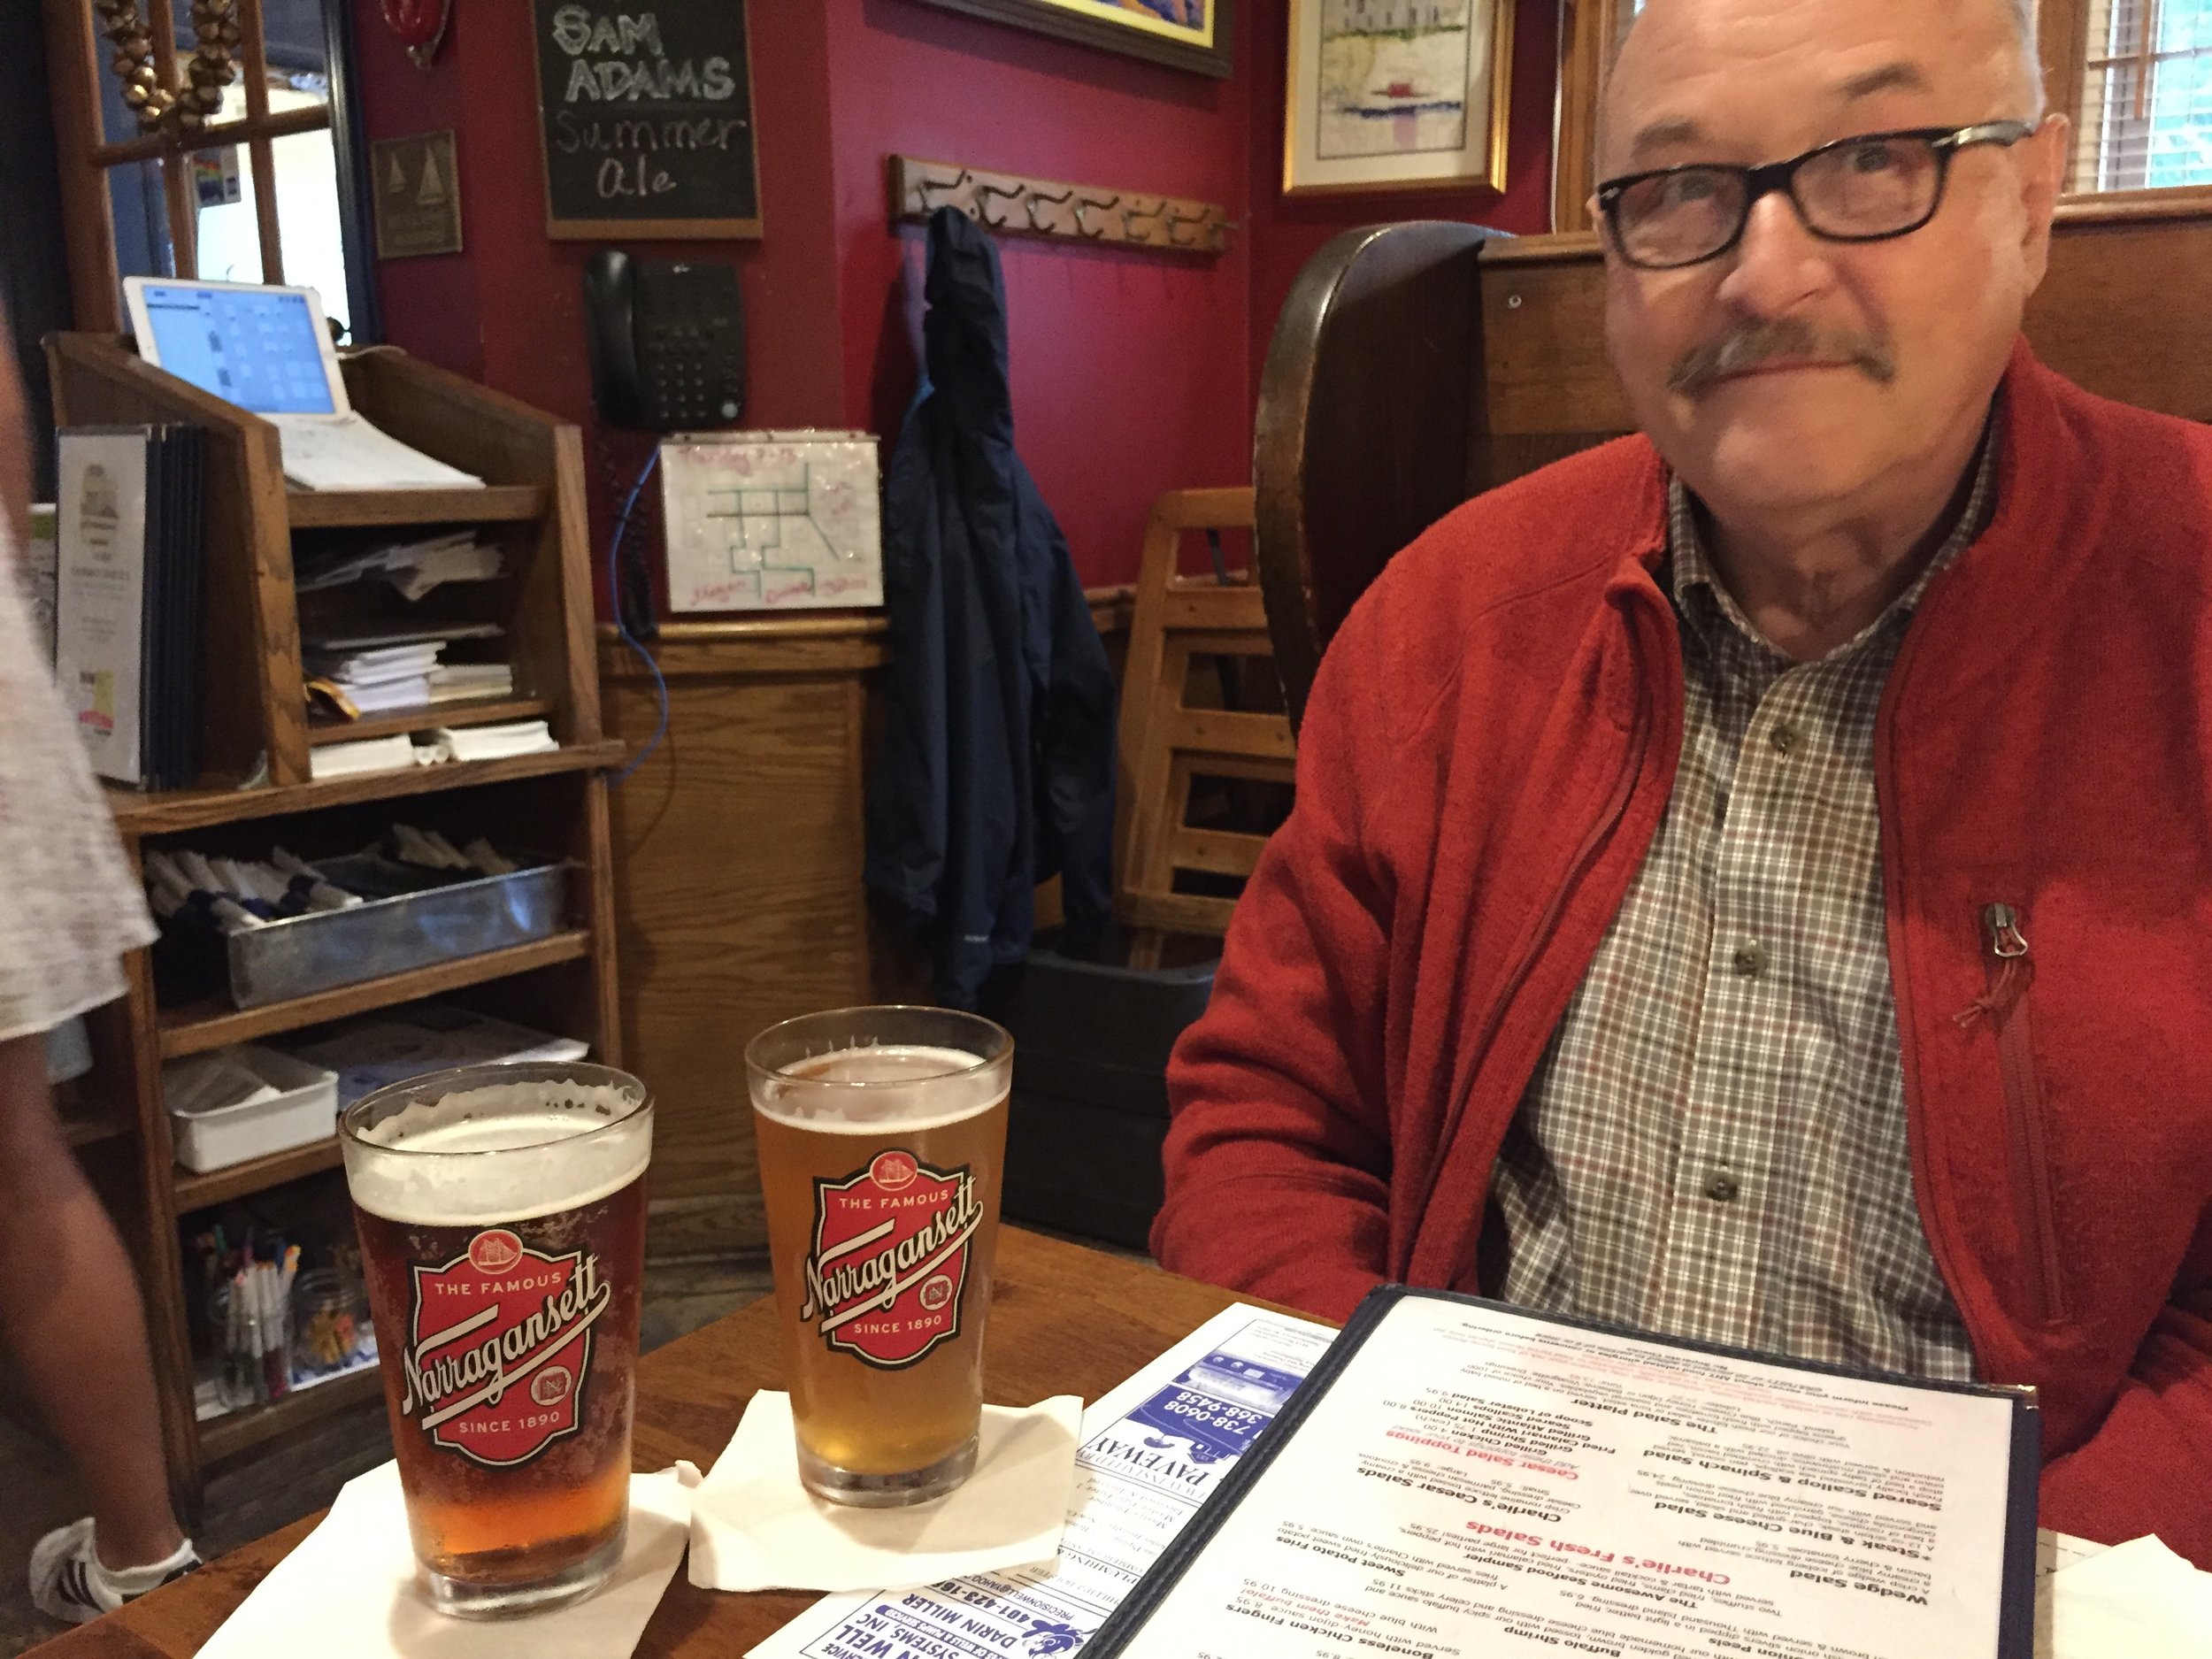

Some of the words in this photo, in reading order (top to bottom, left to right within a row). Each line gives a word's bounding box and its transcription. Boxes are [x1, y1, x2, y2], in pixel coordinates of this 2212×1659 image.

[552, 4, 664, 56] SAM
[565, 57, 735, 102] ADAMS
[556, 111, 747, 153] Summer
[840, 1198, 872, 1210] THE
[880, 1189, 949, 1209] FAMOUS
[801, 1176, 984, 1321] Narragansett
[435, 1283, 472, 1295] THE
[481, 1271, 562, 1293] FAMOUS
[403, 1253, 611, 1416] Narragansett
[854, 1323, 900, 1334] SINCE
[907, 1315, 941, 1331] 1890
[1162, 1399, 1252, 1434] 738-0608
[1174, 1390, 1263, 1425] 368-9458
[1571, 1399, 1628, 1416] Platter
[460, 1420, 511, 1433] SINCE
[518, 1410, 560, 1429] 1890
[1632, 1411, 1681, 1426] Salad
[1686, 1421, 1717, 1433] The
[1386, 1430, 1460, 1455] Toppings
[1087, 1433, 1210, 1486] PAVEWAY
[1465, 1448, 1515, 1467] Salad
[1643, 1449, 1694, 1465] Salad
[1356, 1467, 1414, 1486] Salads
[1518, 1461, 1579, 1480] Caesar
[1699, 1460, 1772, 1480] Spinach
[1417, 1483, 1478, 1504] Caesar
[1797, 1479, 1867, 1497] Scallop
[1482, 1500, 1562, 1523] Charlie's
[1655, 1502, 1708, 1518] Salad
[1872, 1492, 1941, 1511] Seared
[1713, 1513, 1783, 1532] Cheese
[1276, 1536, 1310, 1550] Fries
[1466, 1521, 1543, 1547] Salads
[1789, 1526, 1833, 1541] Blue
[1312, 1546, 1358, 1563] Potato
[1549, 1540, 1615, 1563] Fresh
[1068, 1553, 1138, 1584] PLUMBING
[1361, 1559, 1406, 1577] Sweet
[1463, 1554, 1524, 1571] Sampler
[1622, 1555, 1731, 1585] Charlie's
[1526, 1567, 1587, 1586] Seafood
[1790, 1570, 1847, 1588] Salad
[1591, 1581, 1665, 1601] Awesome
[1854, 1582, 1928, 1606] Wedge
[902, 1593, 964, 1624] MILLER
[1669, 1597, 1697, 1609] The
[856, 1613, 889, 1632] INC
[1225, 1604, 1285, 1625] Fingers
[835, 1624, 894, 1659] WELL
[959, 1618, 1018, 1649] DARIN
[1289, 1621, 1353, 1642] Chicken
[1503, 1626, 1560, 1645] Shrimp
[1358, 1638, 1434, 1659] Boneless
[1563, 1640, 1621, 1658] Buffalo
